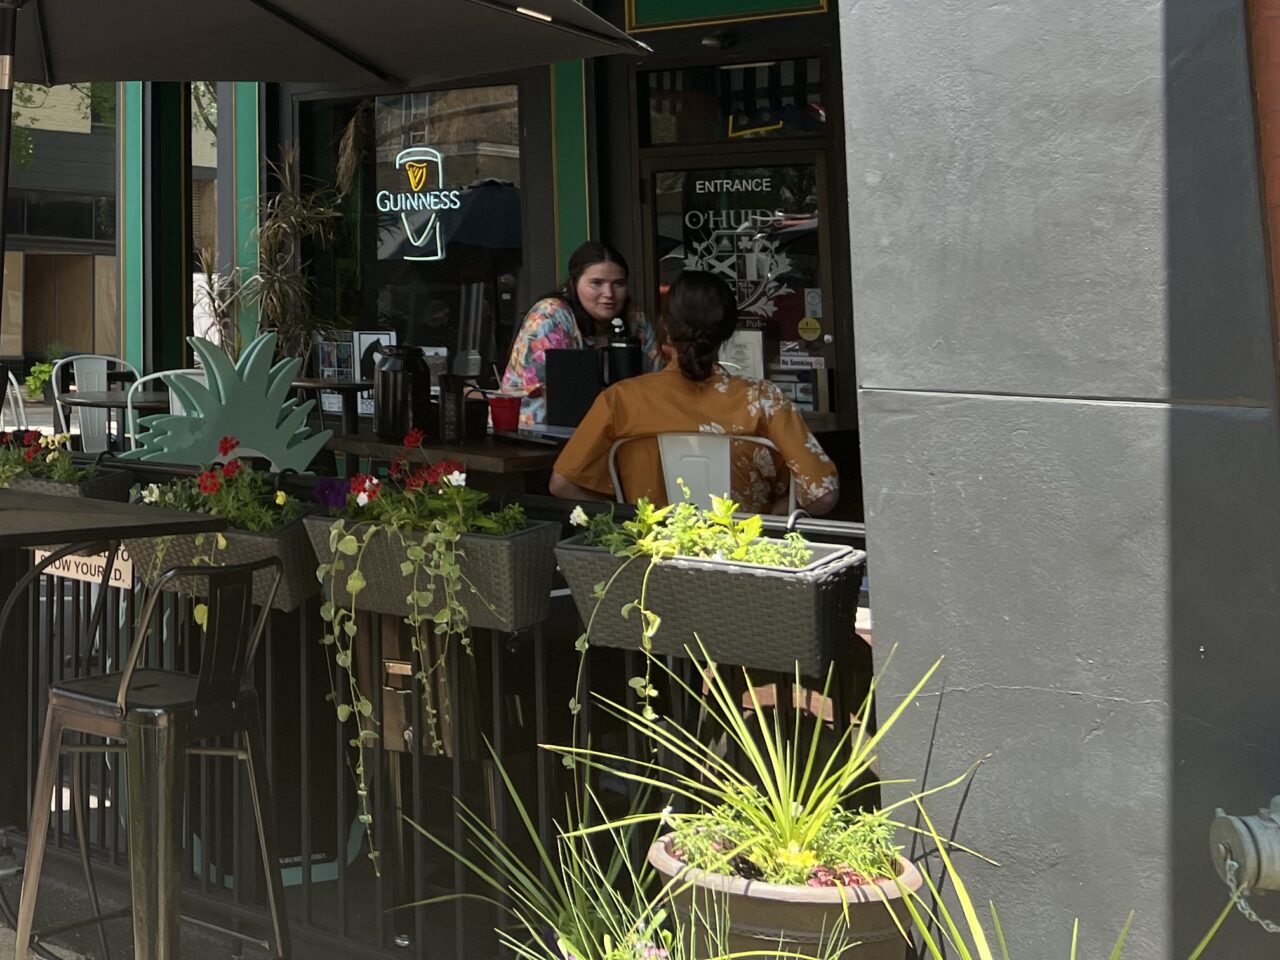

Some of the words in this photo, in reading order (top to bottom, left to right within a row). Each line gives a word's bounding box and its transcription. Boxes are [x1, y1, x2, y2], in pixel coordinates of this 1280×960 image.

[695, 178, 772, 194] ENTRANCE
[376, 190, 461, 212] GUINNESS
[684, 208, 786, 230] O'HUIDS
[40, 554, 72, 572] SOW
[74, 561, 106, 578] YOUR
